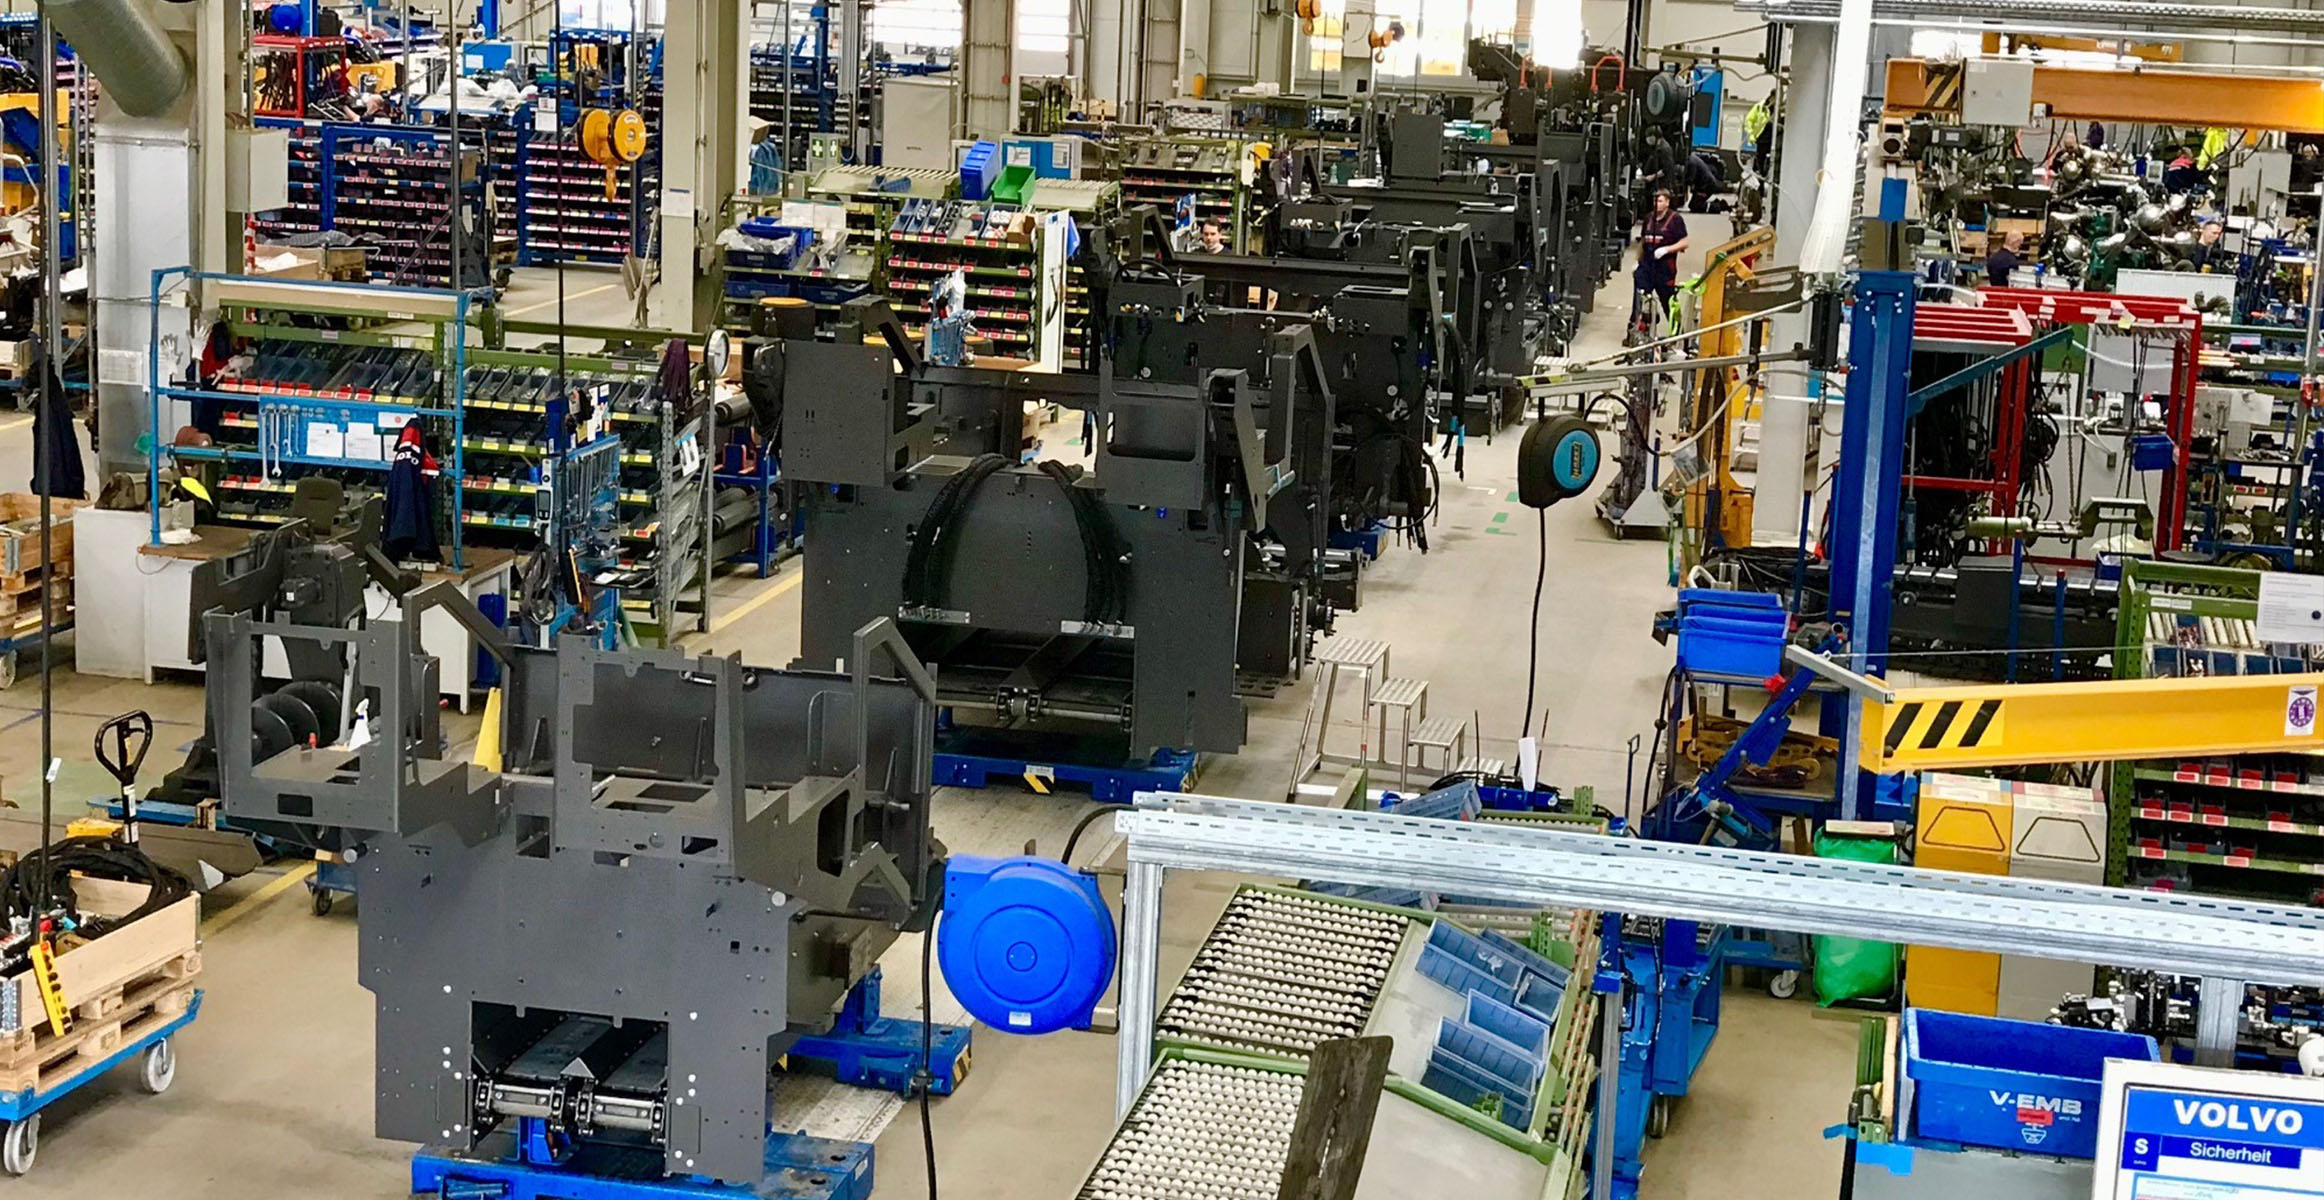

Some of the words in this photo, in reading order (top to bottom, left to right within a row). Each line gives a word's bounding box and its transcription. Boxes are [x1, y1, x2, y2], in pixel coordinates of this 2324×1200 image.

[1988, 1089, 2082, 1115] V-EMB
[2173, 1098, 2304, 1135] VOLVO
[2134, 1138, 2149, 1155] S
[2190, 1141, 2272, 1164] Sicherheit
